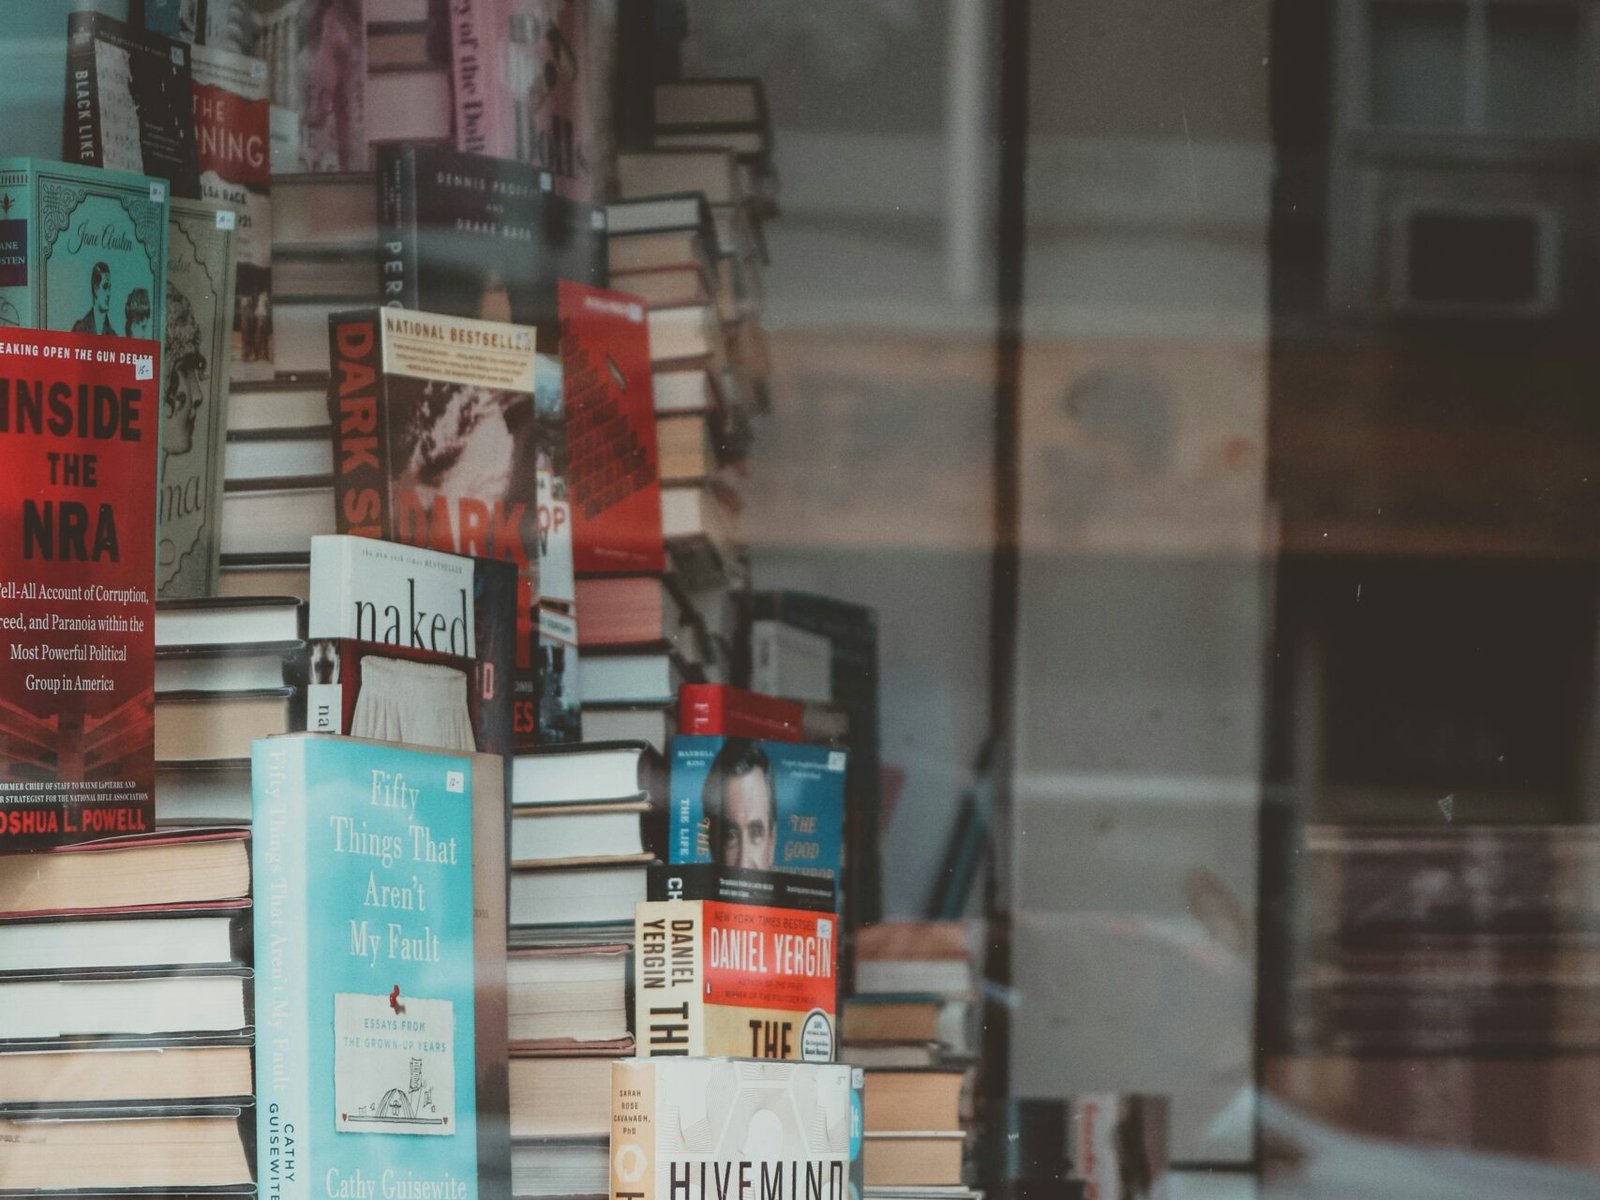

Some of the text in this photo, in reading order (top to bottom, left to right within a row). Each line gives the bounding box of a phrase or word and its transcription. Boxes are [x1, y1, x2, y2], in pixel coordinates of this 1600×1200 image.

[75, 70, 95, 160] BLACK LIKE
[67, 219, 133, 255] Jane Austen
[386, 318, 445, 340] NATIONAL
[43, 346, 71, 360] OPEN
[74, 349, 93, 361] THE
[96, 351, 116, 363] GUN
[336, 321, 380, 476] DARK
[48, 452, 97, 488] THE
[23, 498, 120, 563] NRA
[39, 584, 83, 601] Account
[84, 584, 94, 600] of
[96, 585, 150, 606] Corruption,
[29, 615, 145, 633] and Paranoia within the
[354, 578, 468, 658] naked
[10, 643, 128, 662] Most Powerful Political
[25, 674, 115, 694] Group in America
[6, 794, 45, 804] STRATEGIST
[46, 794, 57, 803] FOR
[58, 794, 69, 802] THE
[69, 793, 96, 802] NATIONAL
[113, 792, 149, 801] ASSOCIATION
[25, 782, 44, 791] CHIEF
[45, 782, 53, 790] OF
[54, 782, 70, 791] STAFF
[71, 782, 79, 790] TO
[125, 781, 136, 789] AND
[371, 769, 420, 818] Fifty
[62, 807, 146, 833] L. POWELL
[680, 799, 691, 823] THE
[330, 815, 458, 869] Things That
[364, 871, 426, 911] Aren't
[733, 913, 755, 925] YORK
[758, 915, 782, 927] TIMES
[349, 919, 440, 968] My Fault
[643, 918, 666, 989] YERGIN
[671, 919, 694, 988] DANIEL
[710, 926, 832, 979] DANIEL YERGIN
[364, 1017, 426, 1032] ESSAYS FROM
[749, 1019, 792, 1059] THE
[344, 1036, 447, 1053] THE GROWN-UP YEARS
[619, 1089, 642, 1097] SARAH
[621, 1102, 639, 1110] ROSE
[284, 1123, 295, 1182] CATHY
[381, 1168, 467, 1200] Guisewite
